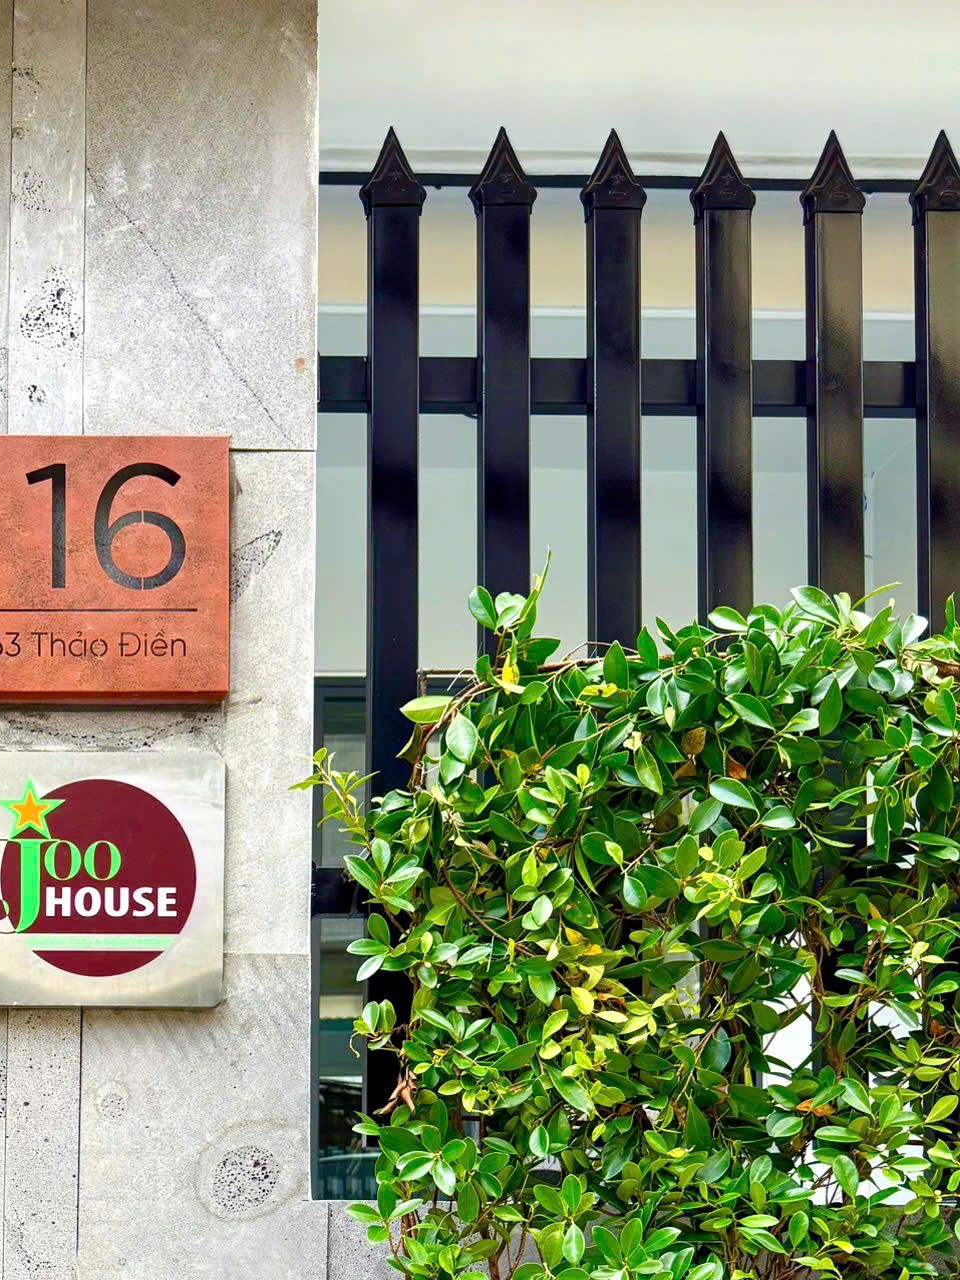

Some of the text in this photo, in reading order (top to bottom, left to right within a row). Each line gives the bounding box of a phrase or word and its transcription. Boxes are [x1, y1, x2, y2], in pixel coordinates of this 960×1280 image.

[25, 462, 187, 591] 16
[30, 629, 109, 658] Thảo
[119, 628, 187, 658] Điền
[45, 886, 178, 918] HOUSE
